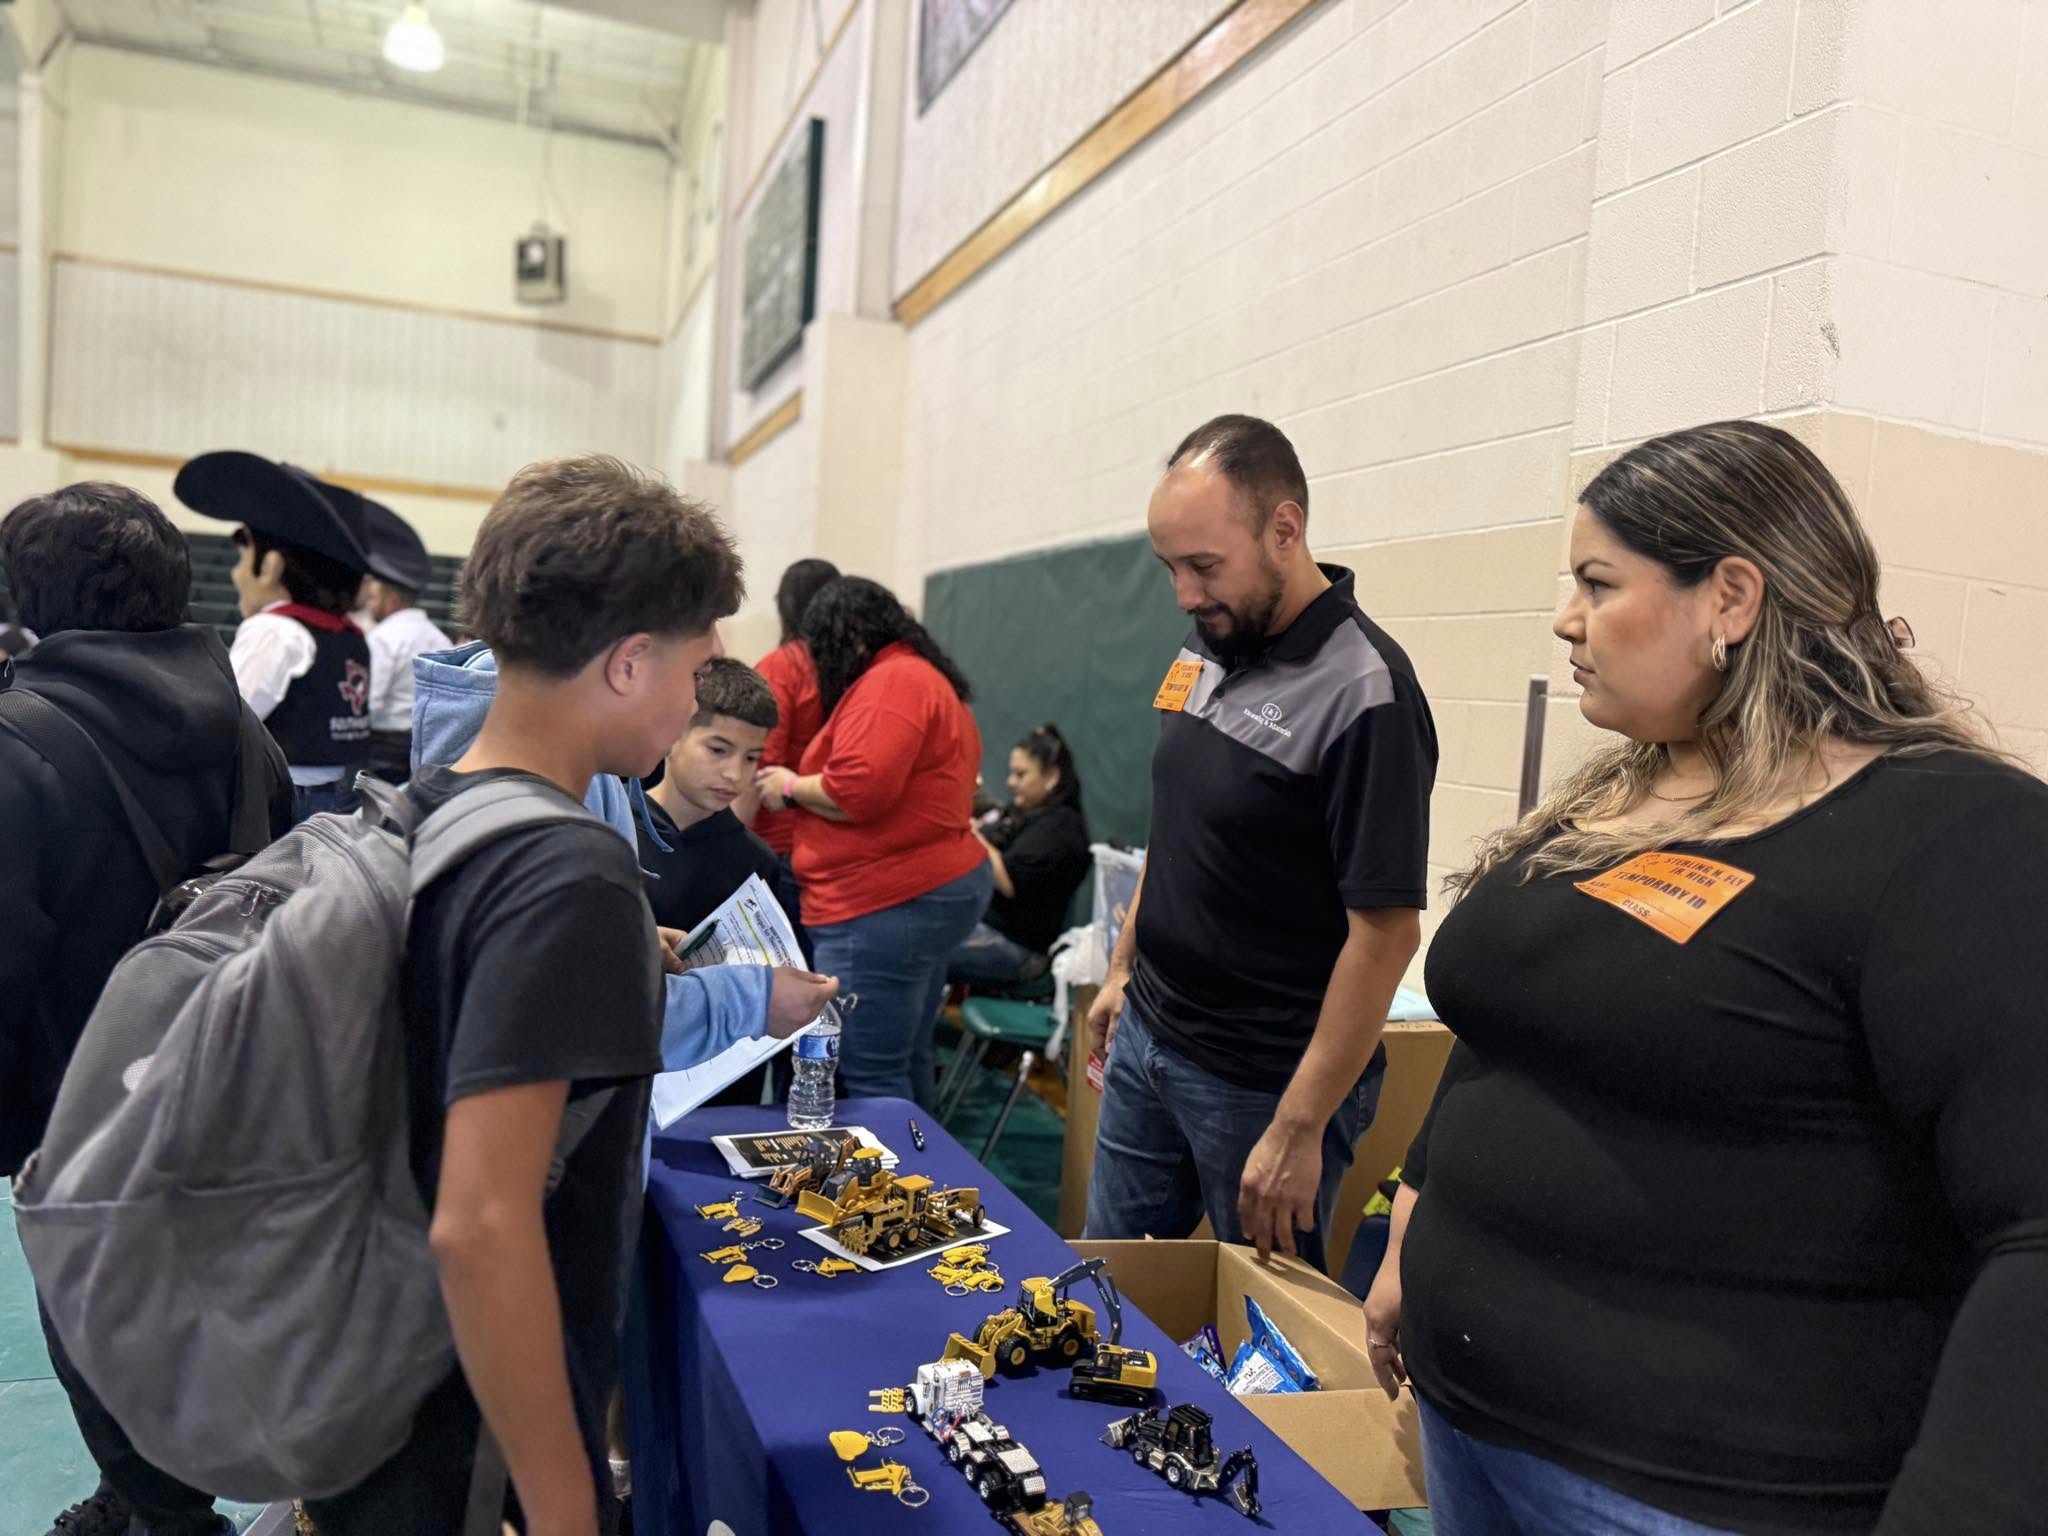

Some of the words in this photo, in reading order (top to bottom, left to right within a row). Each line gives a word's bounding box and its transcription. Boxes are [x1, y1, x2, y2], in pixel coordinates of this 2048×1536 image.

[1664, 857, 1714, 875] STERLING
[1723, 874, 1746, 887] FLY
[1686, 871, 1717, 888] HIGH
[1613, 871, 1691, 900] TEMPORARY
[1686, 895, 1707, 910] ID
